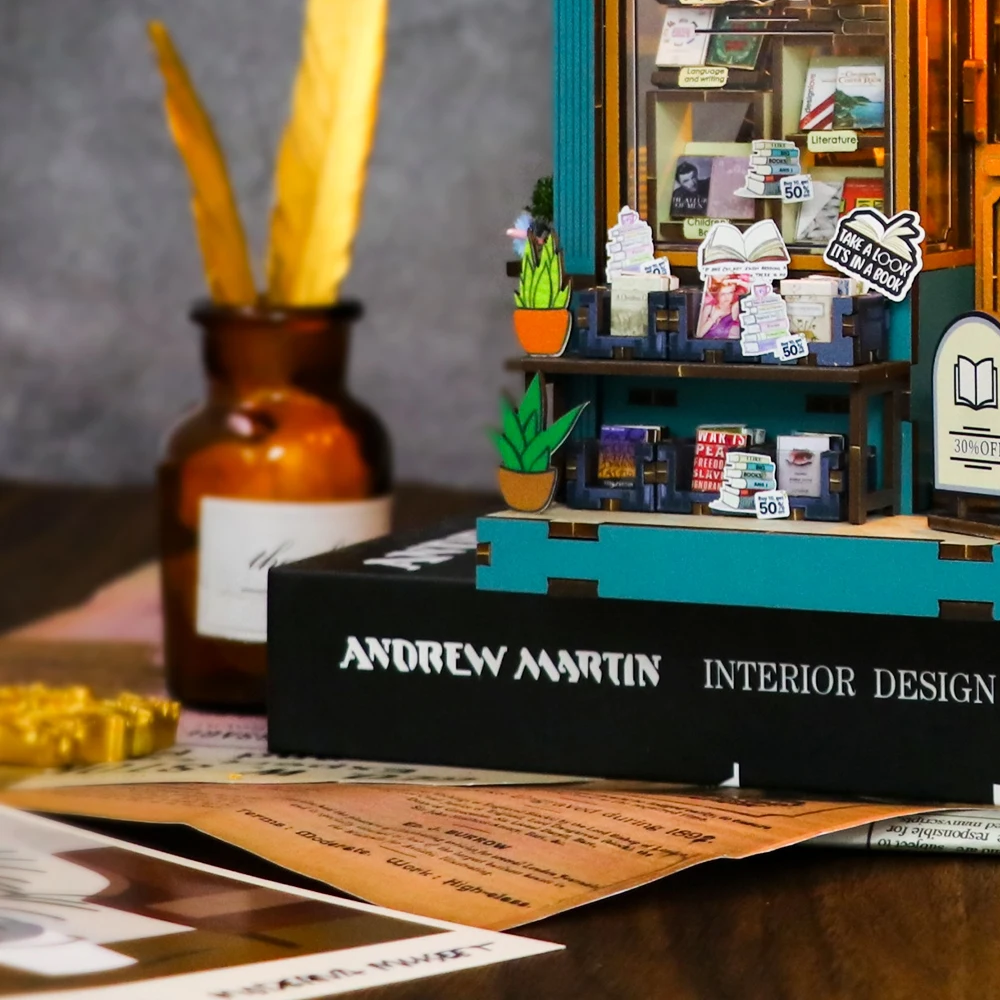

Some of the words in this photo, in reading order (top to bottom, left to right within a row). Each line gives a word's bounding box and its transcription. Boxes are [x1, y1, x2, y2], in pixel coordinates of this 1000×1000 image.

[684, 75, 699, 83] and
[700, 75, 726, 84] writing
[687, 68, 725, 77] Language
[811, 135, 857, 145] Literature
[839, 228, 865, 251] TAKE
[862, 243, 873, 257] A
[872, 247, 912, 278] LOOK
[849, 254, 866, 273] IN
[862, 263, 873, 277] A
[873, 267, 904, 293] BOOK
[698, 429, 727, 444] WAR
[732, 434, 745, 447] IS
[695, 443, 725, 458] PEA
[694, 458, 724, 470] FREEDO
[340, 636, 507, 679] ANDREW
[513, 646, 662, 688] MARTIN
[704, 658, 856, 698] INTERIOR
[873, 667, 996, 706] DESIGN
[886, 824, 908, 838] for
[912, 826, 990, 845] responsible
[443, 828, 513, 851] BURROW
